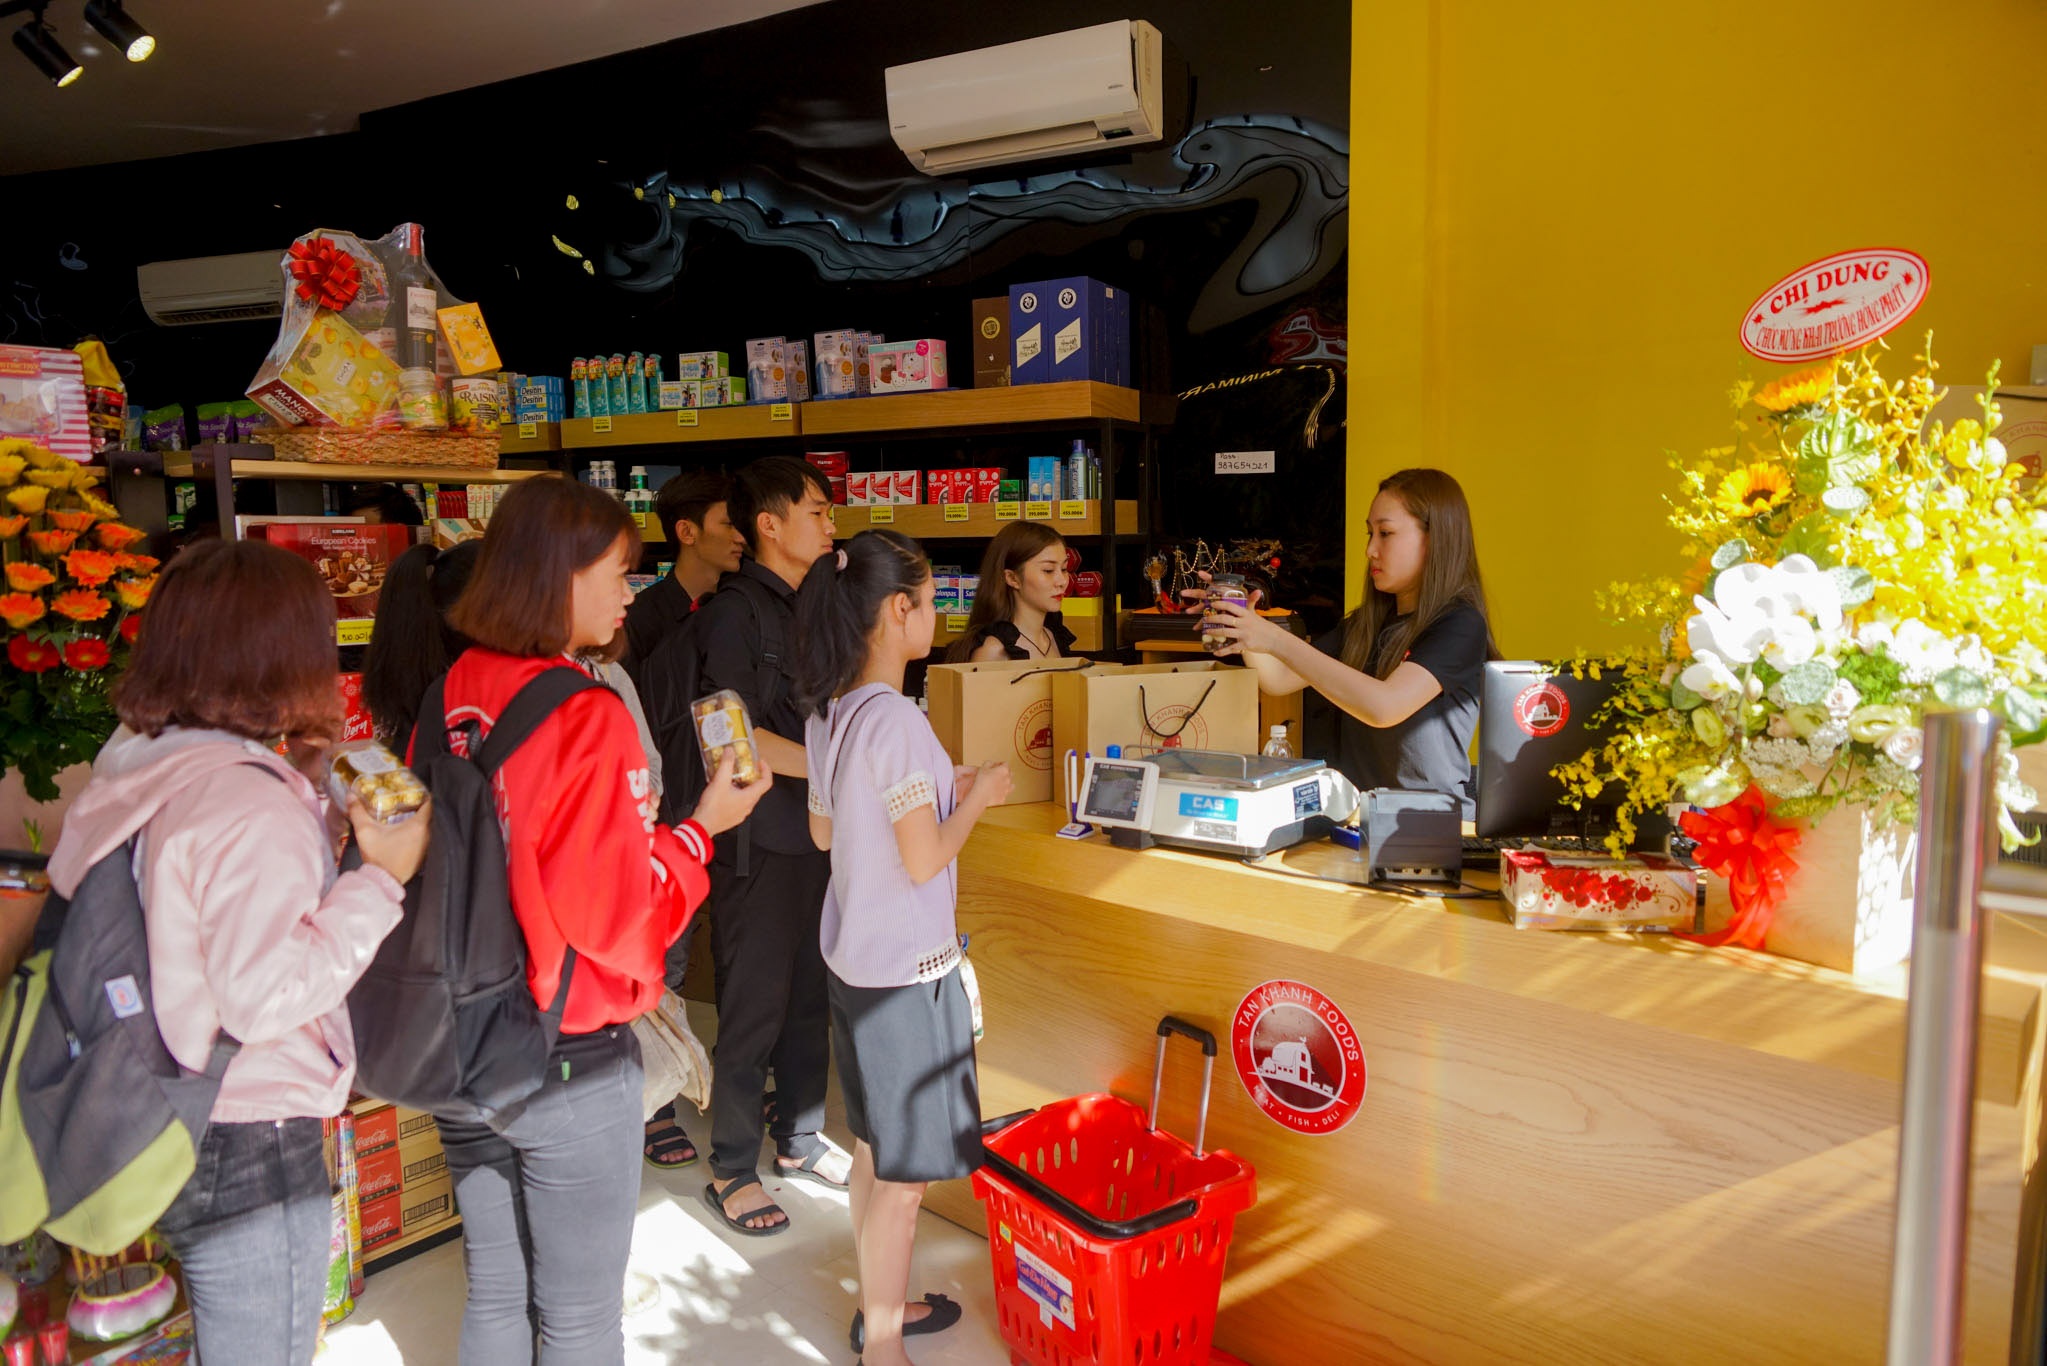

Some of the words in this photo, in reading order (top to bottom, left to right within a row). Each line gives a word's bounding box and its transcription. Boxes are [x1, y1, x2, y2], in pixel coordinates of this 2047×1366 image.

[1769, 279, 1809, 314] CHỊ
[1816, 261, 1890, 292] DUNG
[521, 387, 542, 395] Desitin
[275, 389, 315, 418] MANGO
[522, 396, 543, 404] Desitin
[523, 413, 544, 422] Desitin
[311, 537, 347, 546] European
[347, 536, 377, 545] Cookies
[936, 589, 957, 598] alonpas
[1192, 796, 1225, 811] CAS
[1238, 1001, 1259, 1028] TAN
[1260, 986, 1314, 1005] KHANH
[1288, 1113, 1310, 1127] FISH
[1321, 1110, 1340, 1126] DELI
